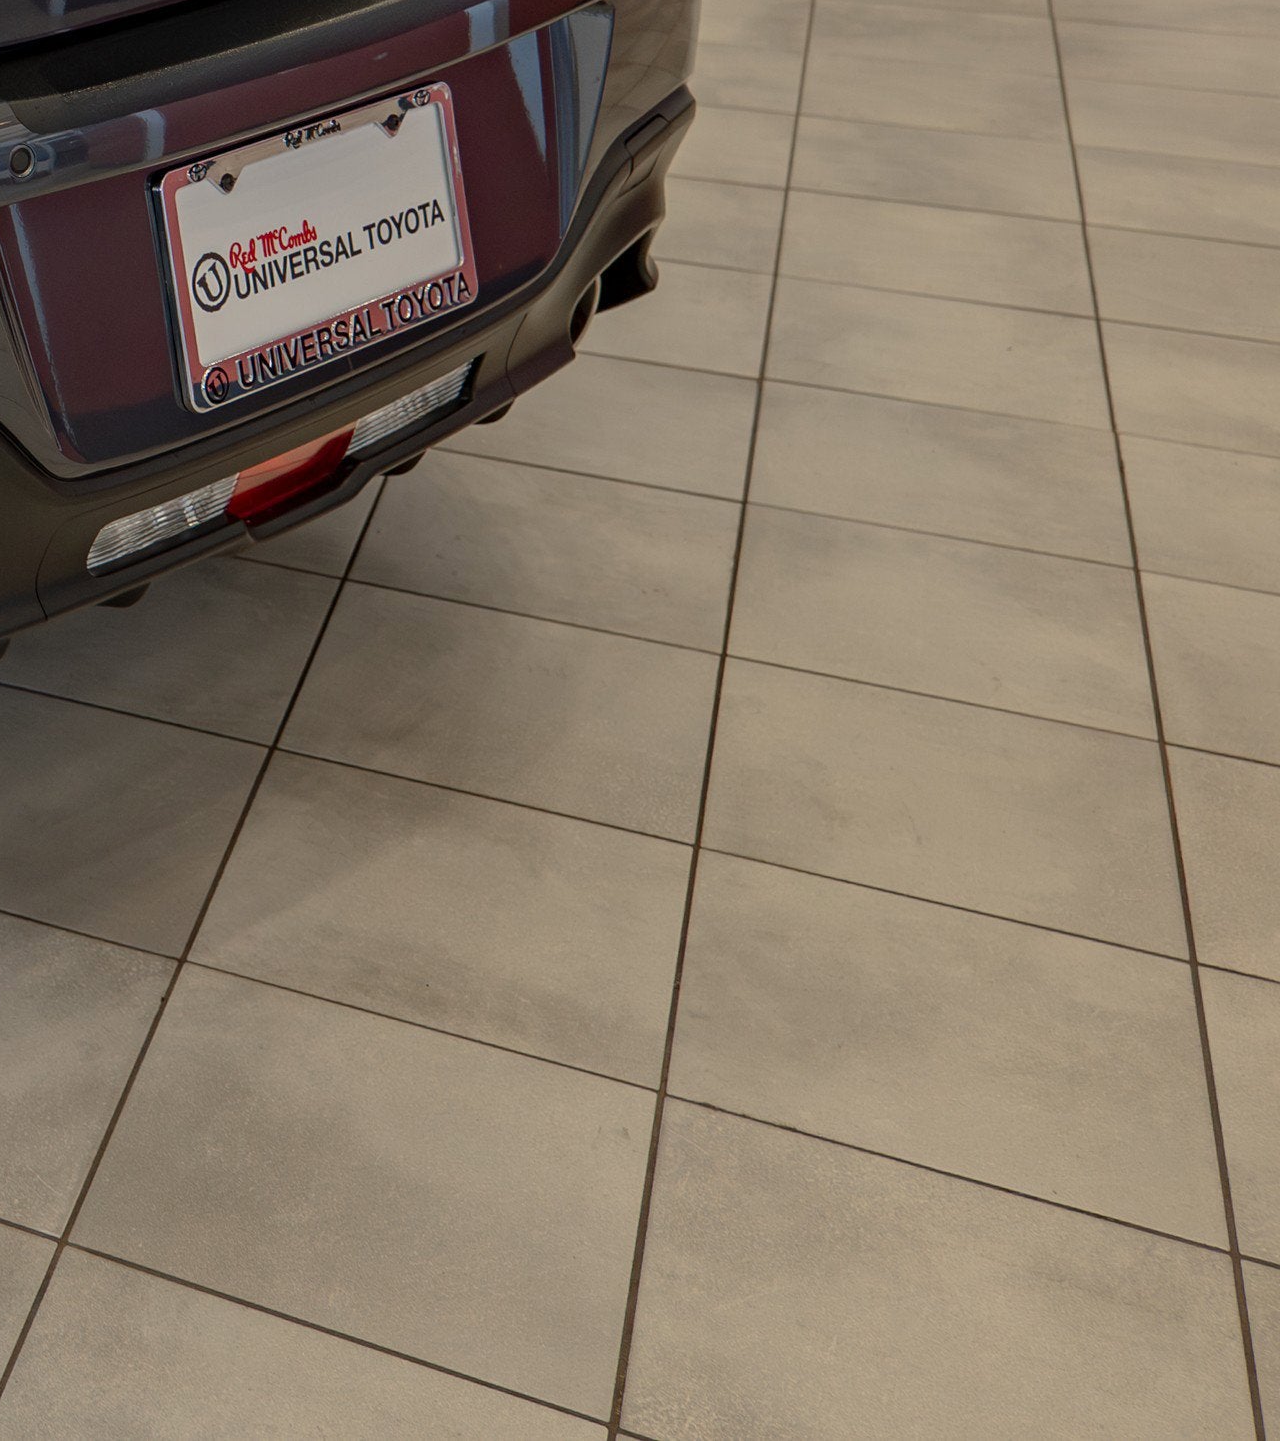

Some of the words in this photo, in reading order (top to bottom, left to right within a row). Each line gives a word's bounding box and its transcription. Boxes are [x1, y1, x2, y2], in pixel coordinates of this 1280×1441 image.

[229, 238, 256, 275] Red
[257, 219, 318, 259] McCombs
[233, 231, 362, 299] UNIVERSAL
[362, 199, 446, 250] TOYOTA
[235, 308, 382, 389] UNIVERSAL
[380, 272, 471, 332] TOYOTA
